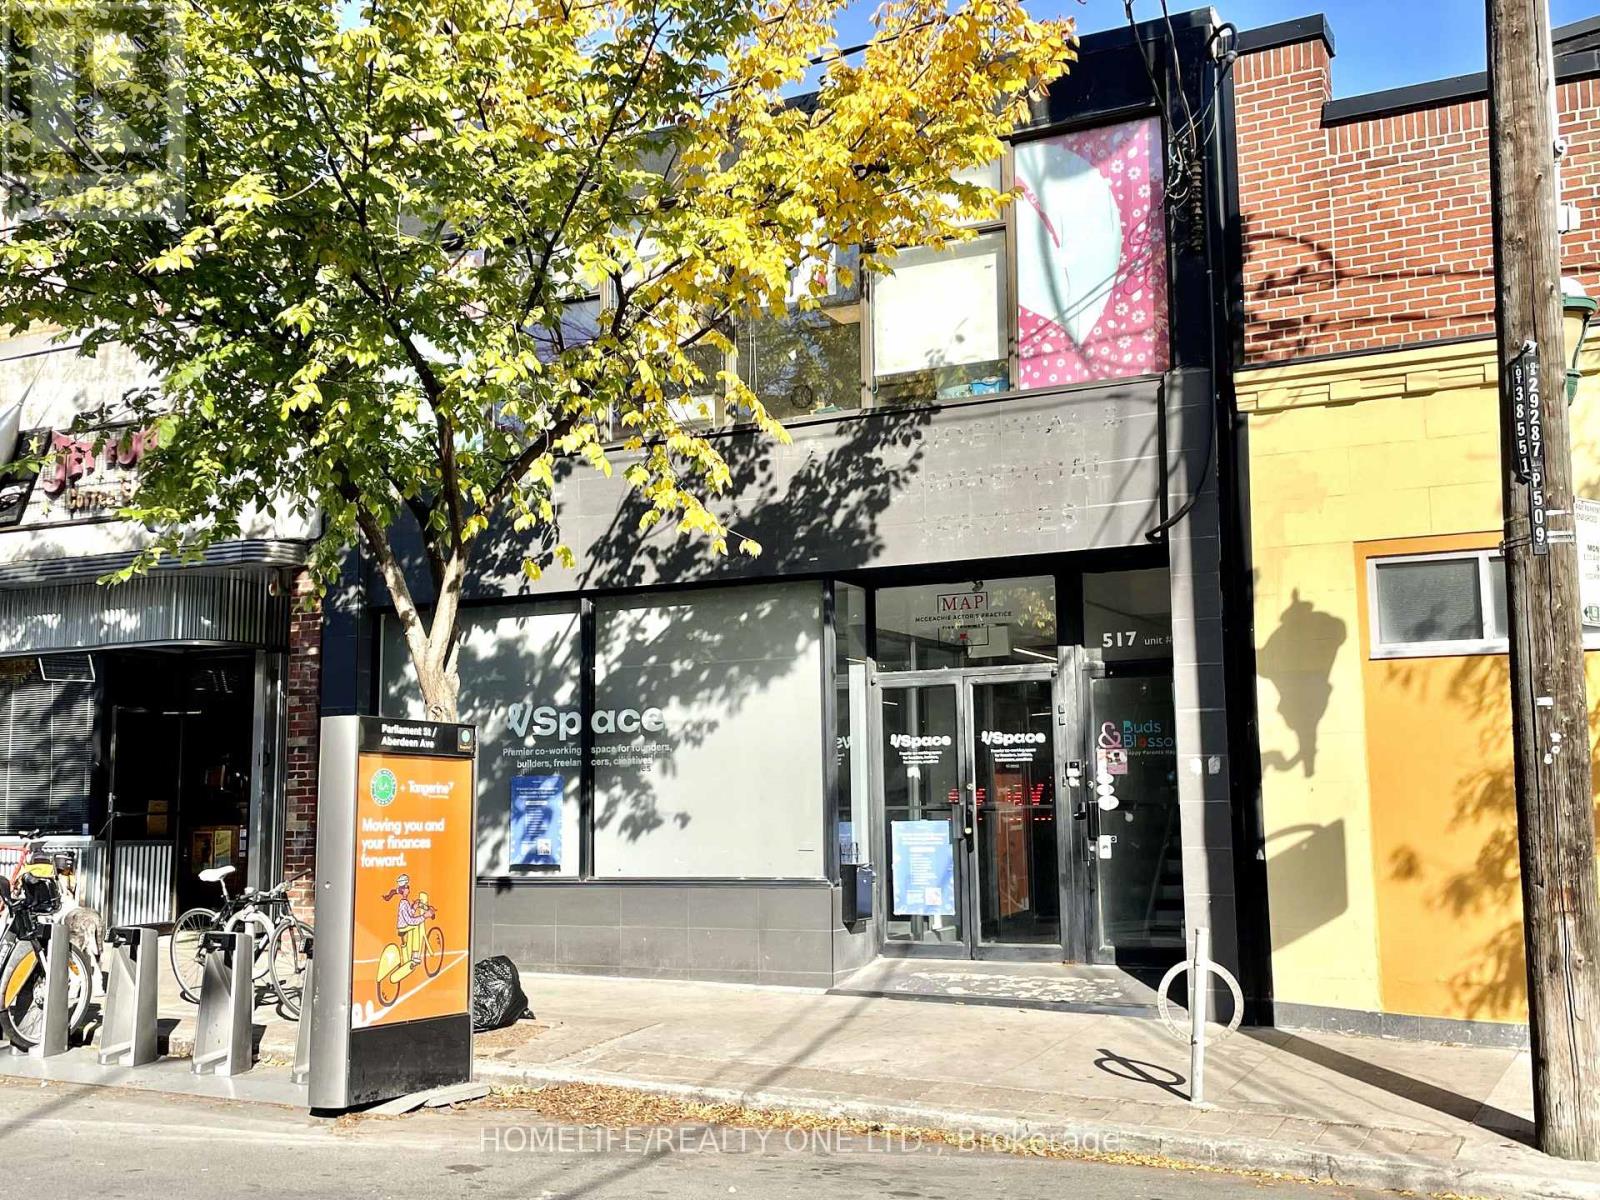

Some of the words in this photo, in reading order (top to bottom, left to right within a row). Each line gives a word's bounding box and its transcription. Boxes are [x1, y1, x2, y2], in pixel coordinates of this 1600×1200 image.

[942, 595, 984, 611] MAP
[1102, 631, 1137, 647] 517
[1144, 636, 1164, 646] unit
[381, 723, 422, 736] Parliament
[423, 727, 432, 736] St
[1124, 720, 1161, 733] Buds
[381, 736, 418, 747] Aberdeen
[420, 739, 435, 748] Ave
[535, 746, 582, 756] co-working
[590, 747, 617, 756] space
[618, 744, 629, 753] for
[362, 818, 401, 834] Moving
[404, 821, 423, 833] you
[425, 818, 445, 832] and
[362, 838, 385, 850] your
[387, 836, 431, 849] finances
[361, 853, 406, 868] forward.
